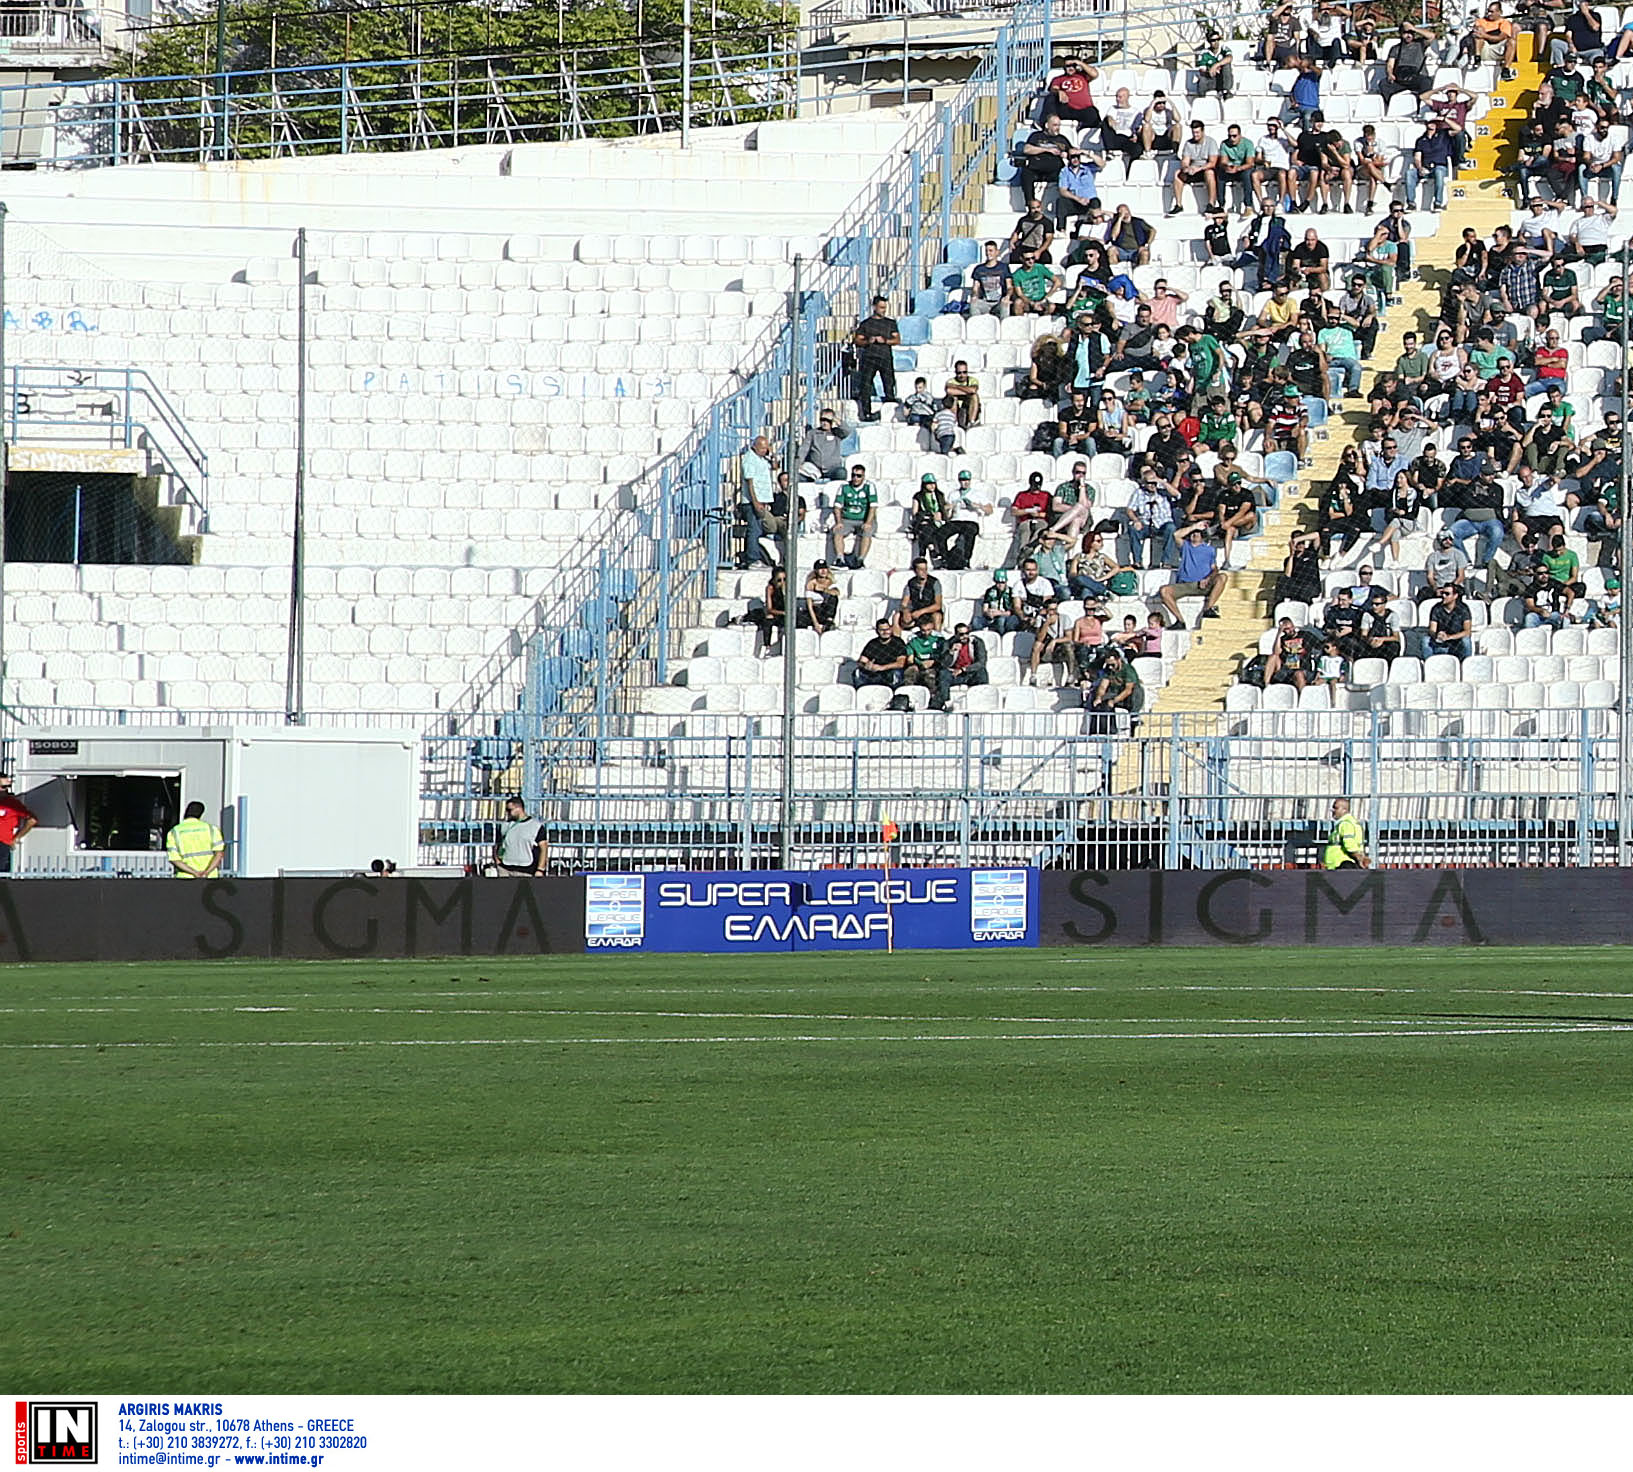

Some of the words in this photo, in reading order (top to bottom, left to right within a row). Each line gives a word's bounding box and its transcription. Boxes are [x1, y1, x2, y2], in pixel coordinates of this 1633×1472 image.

[1477, 127, 1488, 136] 22
[1453, 189, 1464, 197] 20
[31, 741, 77, 749] ISOBOX
[658, 881, 791, 907] SUPER
[802, 878, 959, 906] LEAGUE
[978, 885, 1021, 894] SUPER
[592, 890, 638, 899] SUPER
[1061, 869, 1488, 945] SIGMA
[195, 877, 552, 957] SIGMA
[588, 913, 641, 922] LEAGUE
